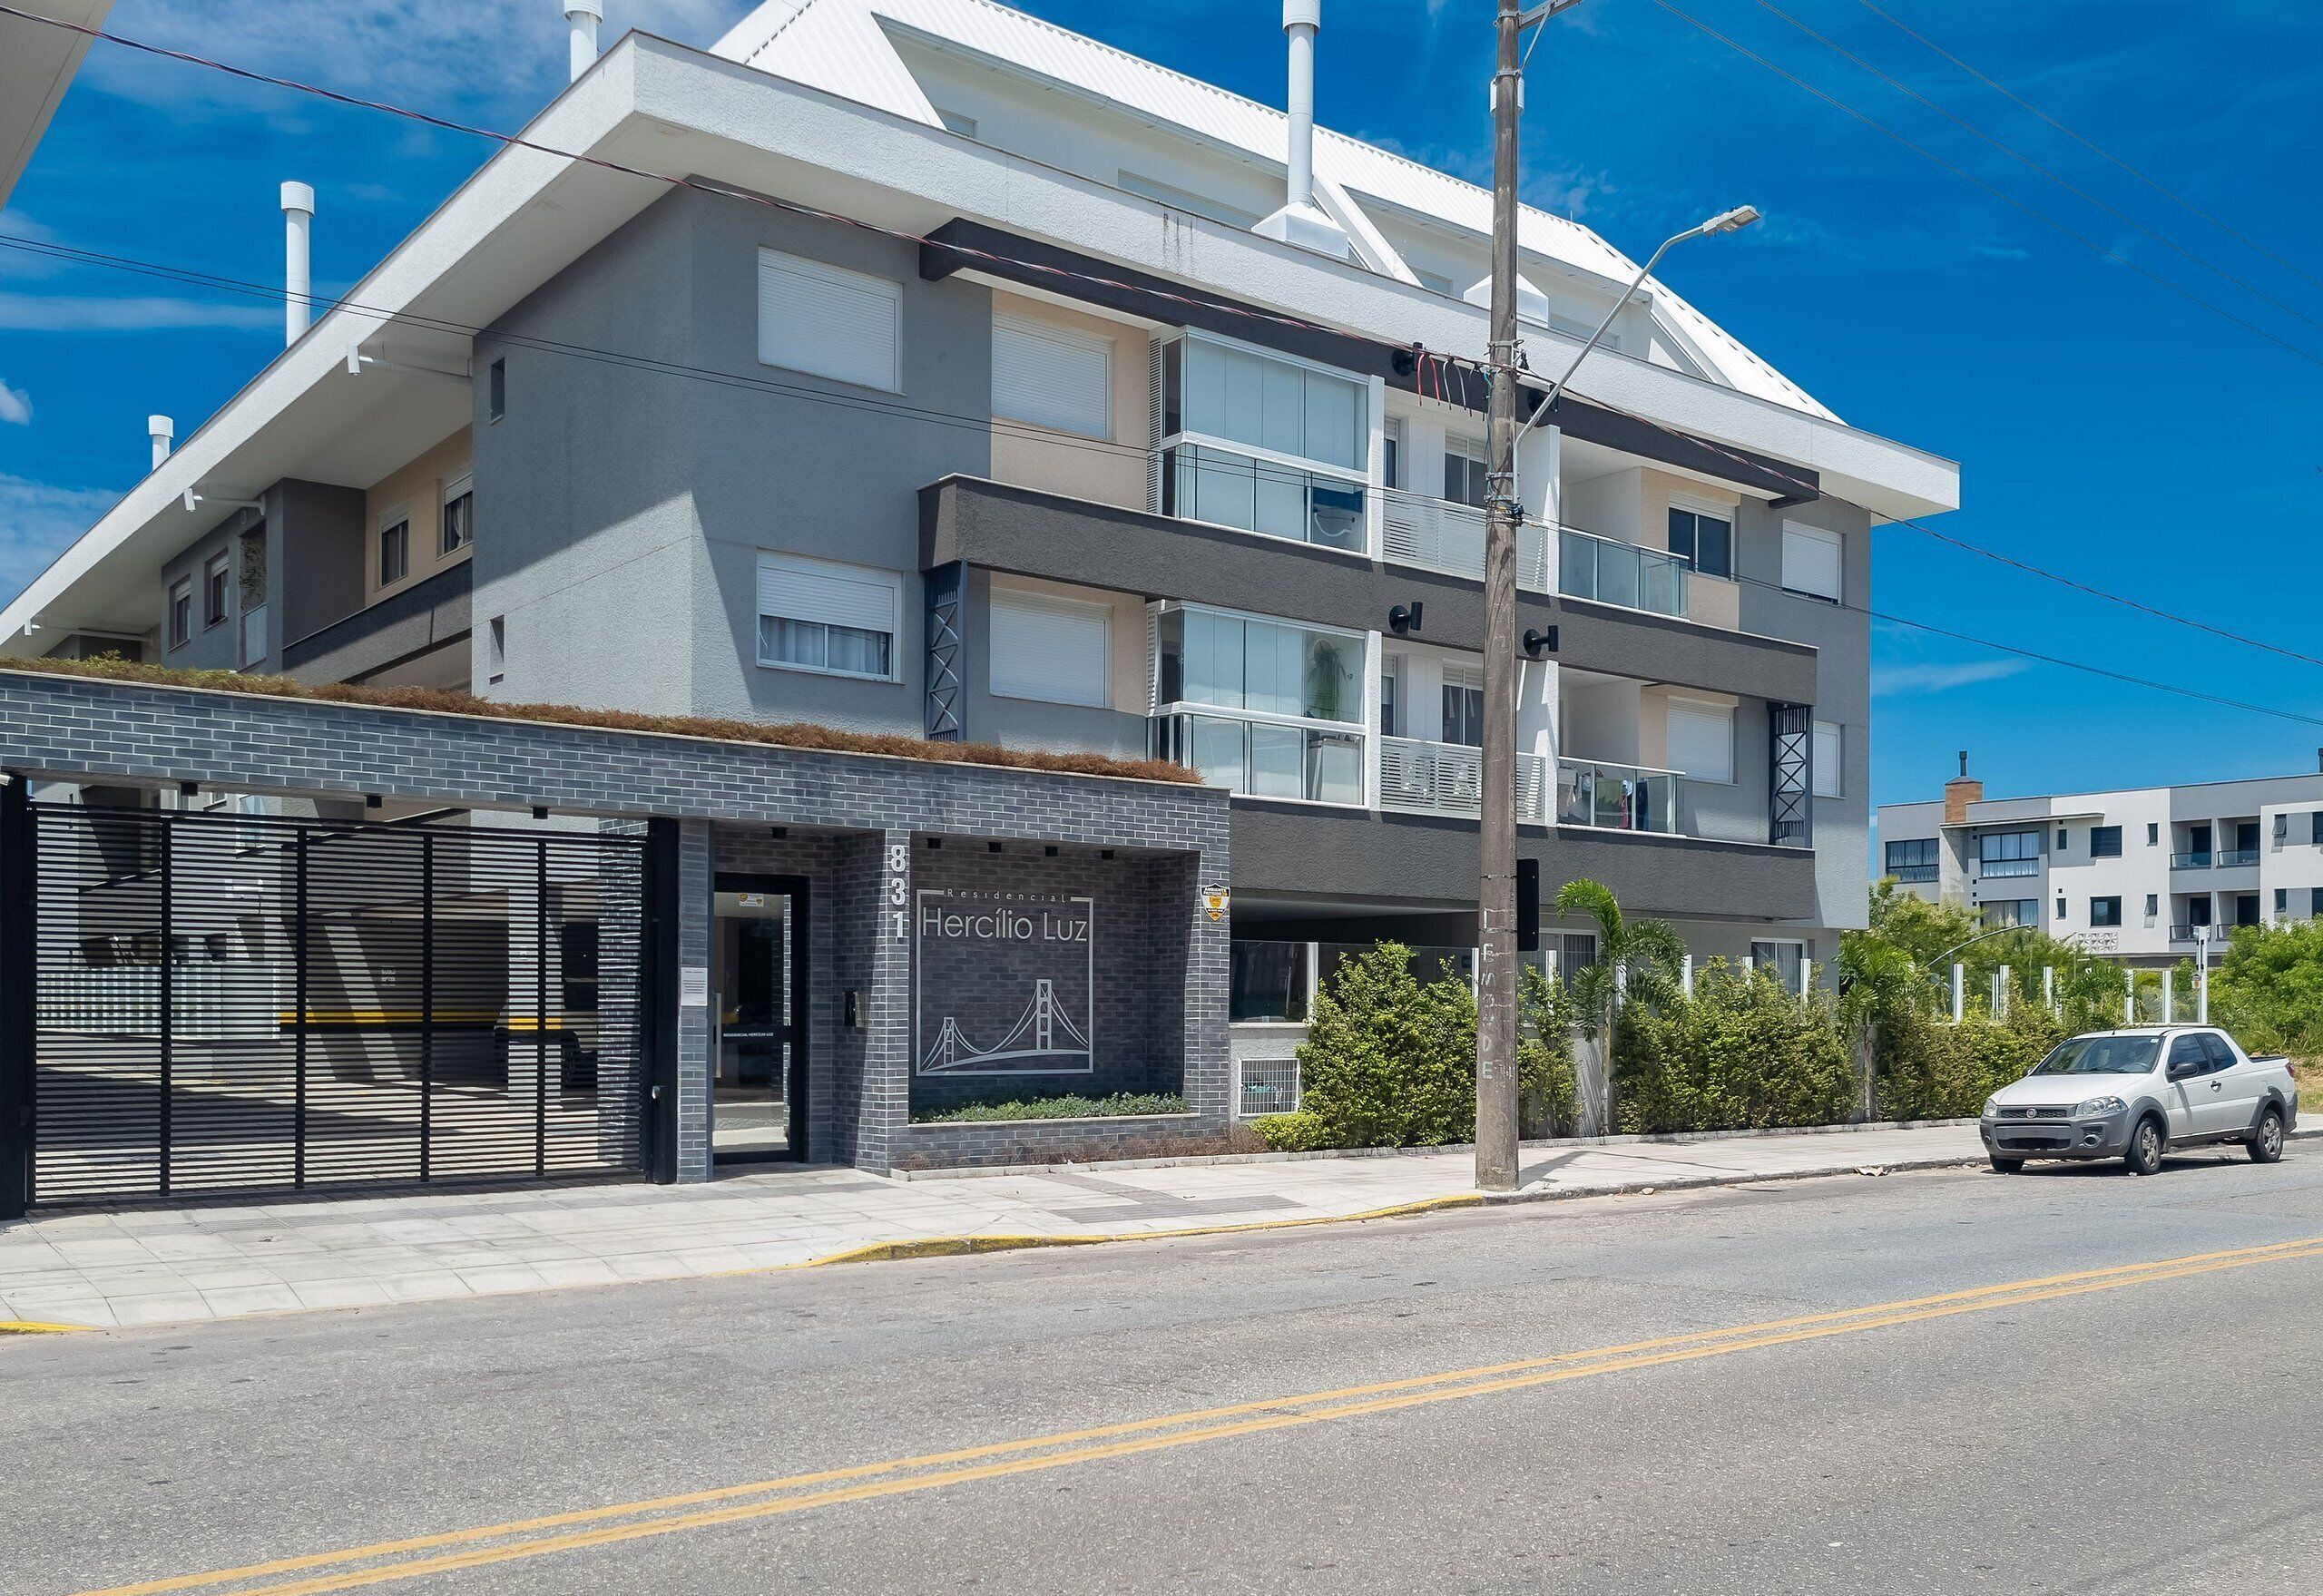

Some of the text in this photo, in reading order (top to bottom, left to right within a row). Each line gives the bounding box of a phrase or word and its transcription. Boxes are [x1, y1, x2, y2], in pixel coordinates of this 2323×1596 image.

[891, 845, 906, 938] 831
[947, 888, 1065, 903] Residencial
[923, 906, 1087, 942] Hercílio Luz
